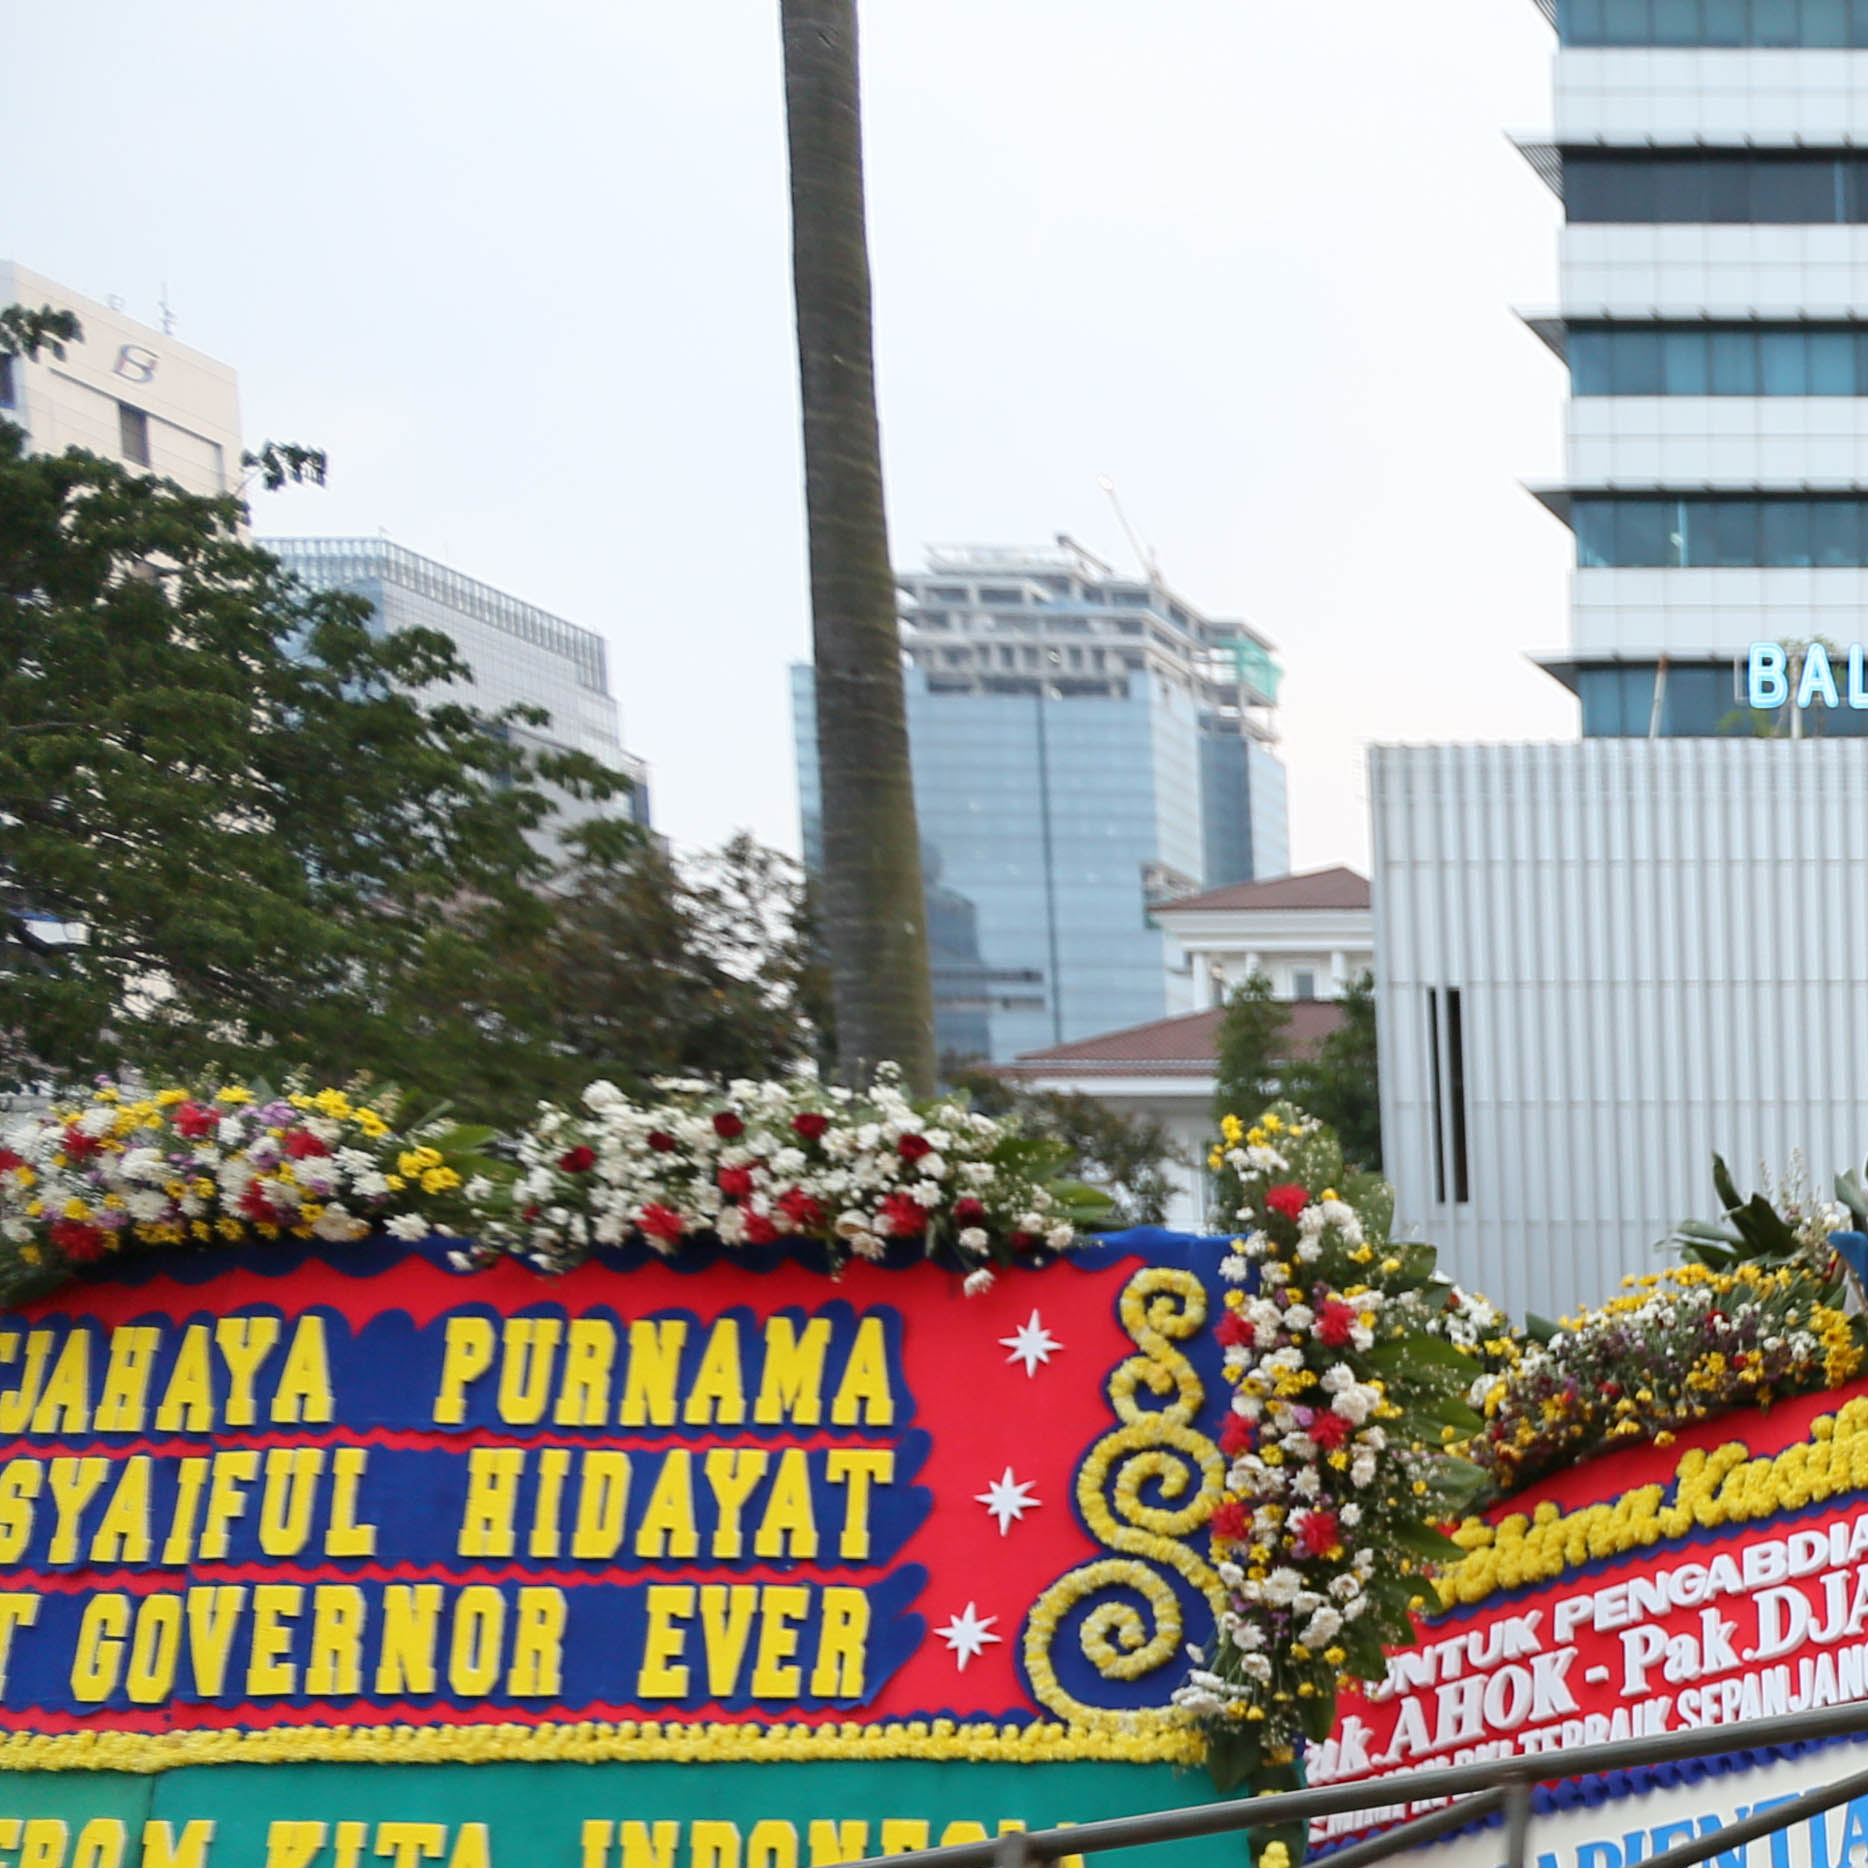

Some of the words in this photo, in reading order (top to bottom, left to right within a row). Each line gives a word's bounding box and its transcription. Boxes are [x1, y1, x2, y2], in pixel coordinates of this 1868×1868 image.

[0, 1316, 334, 1434] JAHAYA
[433, 1317, 894, 1426] PURNAMA
[0, 1447, 377, 1565] SYAIFUL
[458, 1448, 894, 1560] HIDAYAT
[71, 1584, 566, 1703] GOVERNOR
[638, 1585, 870, 1698] EVER
[1304, 1646, 1581, 1786] ak.AHOK
